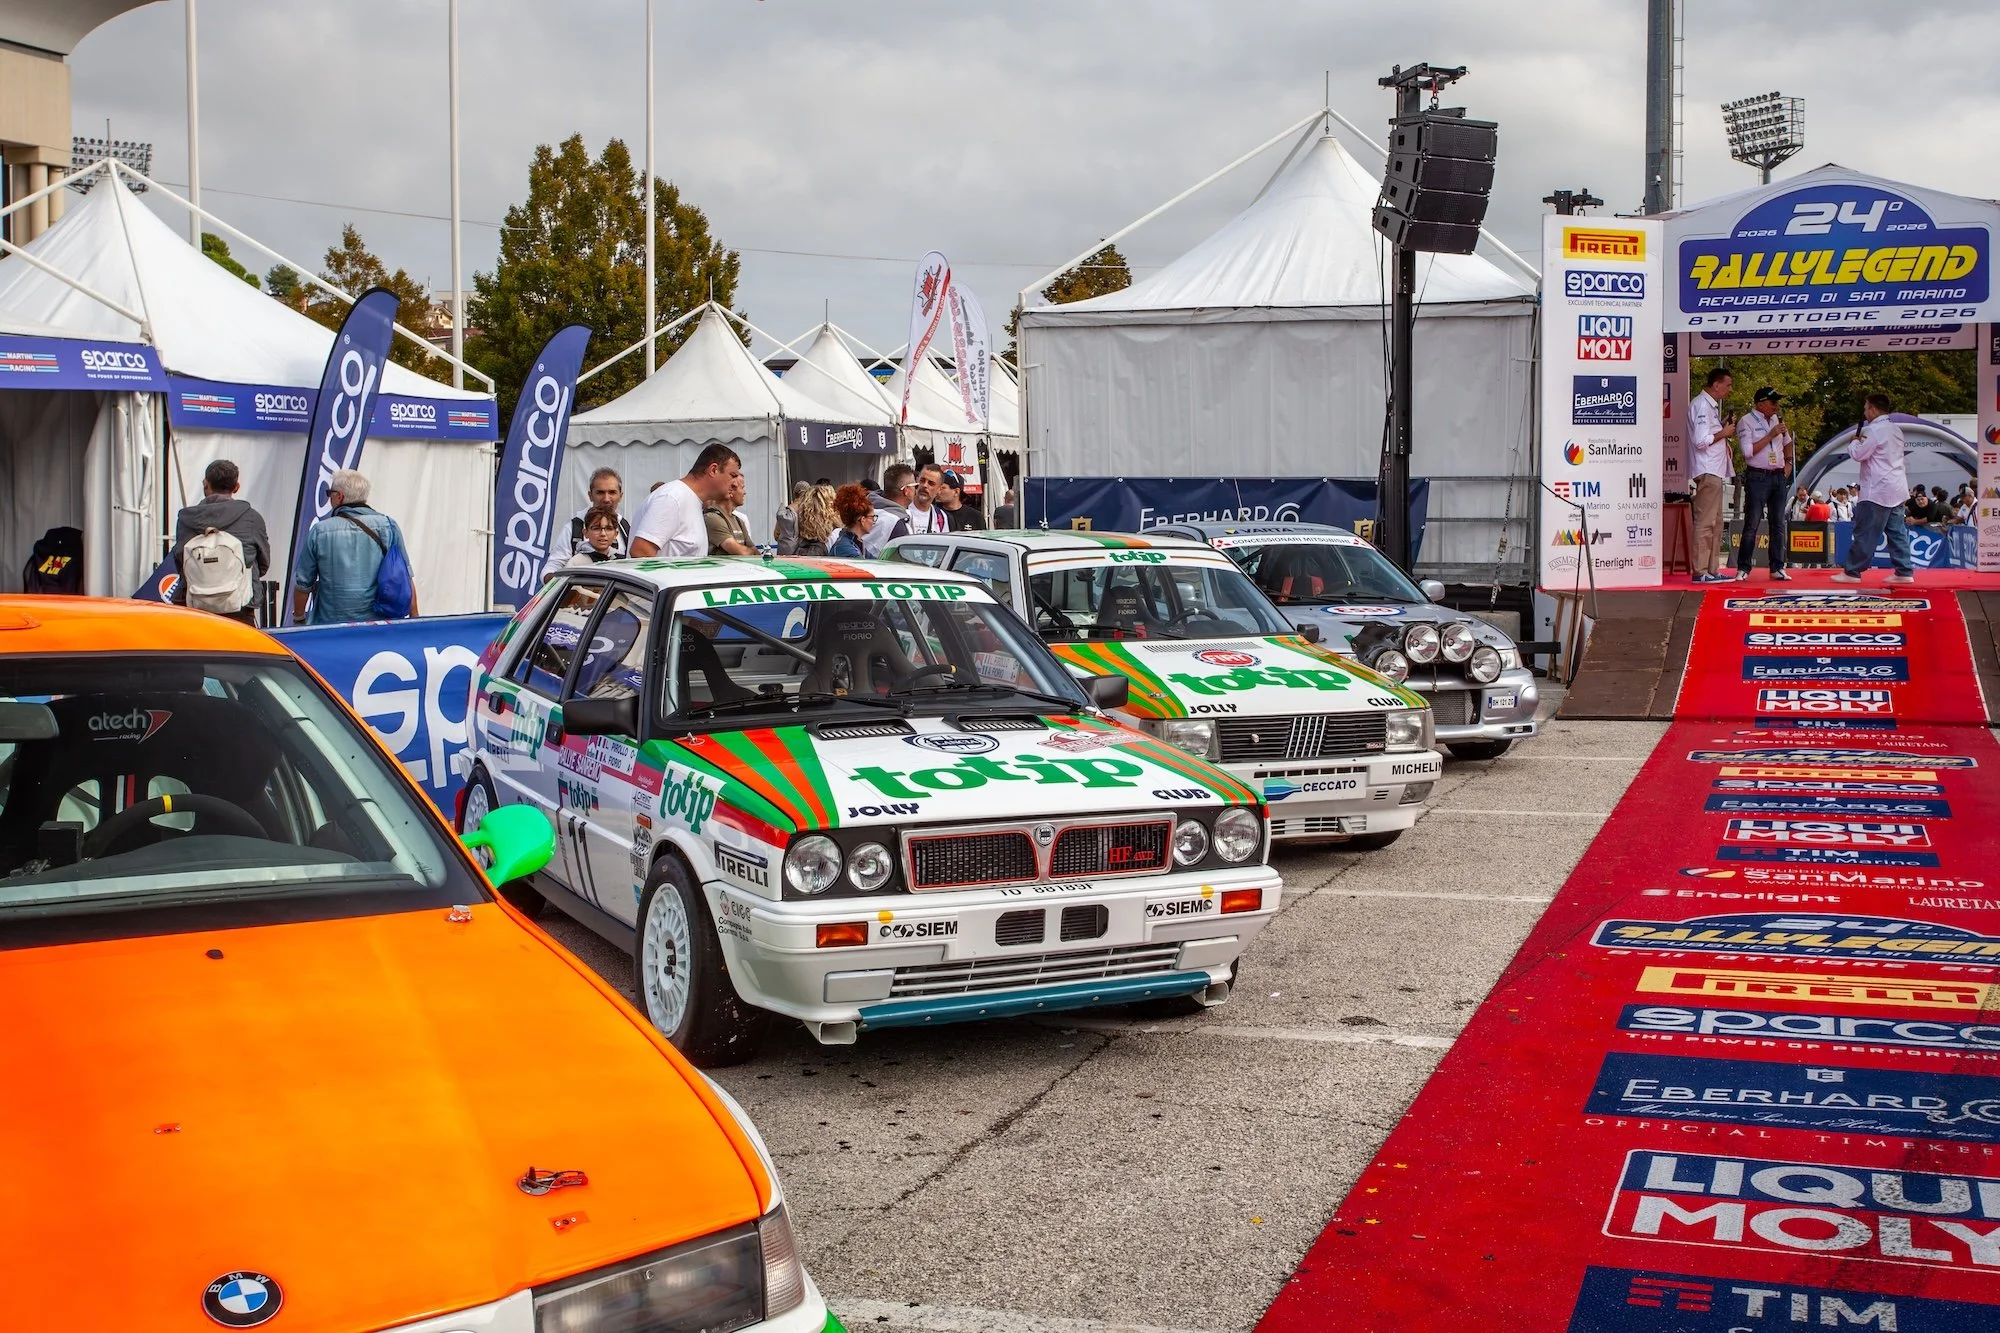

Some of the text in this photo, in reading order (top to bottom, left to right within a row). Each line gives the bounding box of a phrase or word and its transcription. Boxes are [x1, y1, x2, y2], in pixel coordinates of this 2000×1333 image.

[1737, 229, 1777, 238] 2026
[1886, 222, 1928, 232] 2026
[1570, 232, 1639, 256] PIRELLI
[1689, 245, 1979, 290] RALLYLEGEND
[1567, 272, 1643, 297] sparco
[1698, 288, 1967, 307] REPUBBLICA DI SAN MARINO
[1757, 311, 1881, 324] OTTOBRE
[1900, 307, 1977, 319] 2026
[1580, 316, 1630, 338] LIQUI
[1579, 338, 1631, 360] MOLY
[1767, 338, 1871, 349] OTTOBRE
[1888, 336, 1952, 347] 2026
[6, 352, 34, 360] MARTINI
[81, 349, 149, 372] sparco
[9, 364, 37, 373] RACING
[254, 392, 309, 414] sparco
[1574, 393, 1622, 406] EBERHARD
[200, 405, 219, 413] RACING
[390, 402, 436, 422] sparco
[826, 427, 857, 445] EBERHARD
[1588, 443, 1643, 456] SanMarino
[500, 375, 563, 591] sparco
[1572, 481, 1601, 498] TIM
[1587, 502, 1611, 510] Marino
[1617, 502, 1658, 510] SAN MARINO
[1625, 513, 1650, 521] OUTLET
[1240, 526, 1292, 534] VARTA
[1232, 536, 1351, 545] CONCESSIONARI MITSUBISHI
[1793, 536, 1819, 548] PIRELLI
[1109, 550, 1167, 563] totip
[1595, 557, 1633, 569] Enerlight
[702, 583, 968, 607] LANCIA TOTIP
[1763, 615, 1887, 625] PIRELLI
[1748, 632, 1902, 646] sparco
[1203, 653, 1247, 662] FIAT
[1753, 665, 1866, 676] EBERHARD
[1167, 666, 1353, 697] totip
[1367, 697, 1404, 707] CLUB
[1767, 690, 1884, 701] LIQUI
[1189, 702, 1237, 715] JOLLY
[1765, 700, 1888, 712] MOLY
[88, 708, 148, 732] atech
[119, 732, 142, 741] racing
[848, 754, 1144, 799] totip
[1152, 788, 1212, 801] CLUB
[1303, 779, 1357, 793] CECCATO
[1718, 779, 1938, 793] sparco
[569, 780, 590, 819] totip
[660, 768, 715, 836] totip
[1720, 800, 1889, 811] EBERHARD
[848, 802, 920, 819] JOLLY
[1739, 819, 1916, 835] LIQUI
[1737, 829, 1924, 845] MOLY
[1109, 846, 1133, 864] HF
[1785, 848, 1860, 858] TIM
[714, 839, 769, 888] PIRELLI
[1834, 858, 1922, 867] Marino
[1743, 870, 1985, 889] SanMarino
[1747, 880, 1968, 893] www.visitsanmarino.com
[1675, 889, 1841, 903] Enerlight
[1166, 899, 1204, 916] SIEM
[916, 920, 958, 937] SIEM
[1610, 925, 2000, 956] RALLYLEGEN
[1612, 938, 1788, 952] REPUBBLICA
[1852, 950, 1913, 959] SAN
[1671, 971, 1982, 1006] PIRELLI
[1626, 1033, 2000, 1062] THE POWER OF PERFORMAN
[1622, 1078, 1949, 1111] EBERHARD
[1617, 1103, 1739, 1122] Manufacture
[1742, 1110, 1807, 1126] Suisse
[1585, 1118, 1994, 1157] OFFICIAL TIMEKEE
[1643, 1156, 2000, 1219] LIQUI
[1631, 1195, 2000, 1267] MOLY
[208, 1272, 271, 1294] BMW
[1731, 1287, 1898, 1333] TIM
